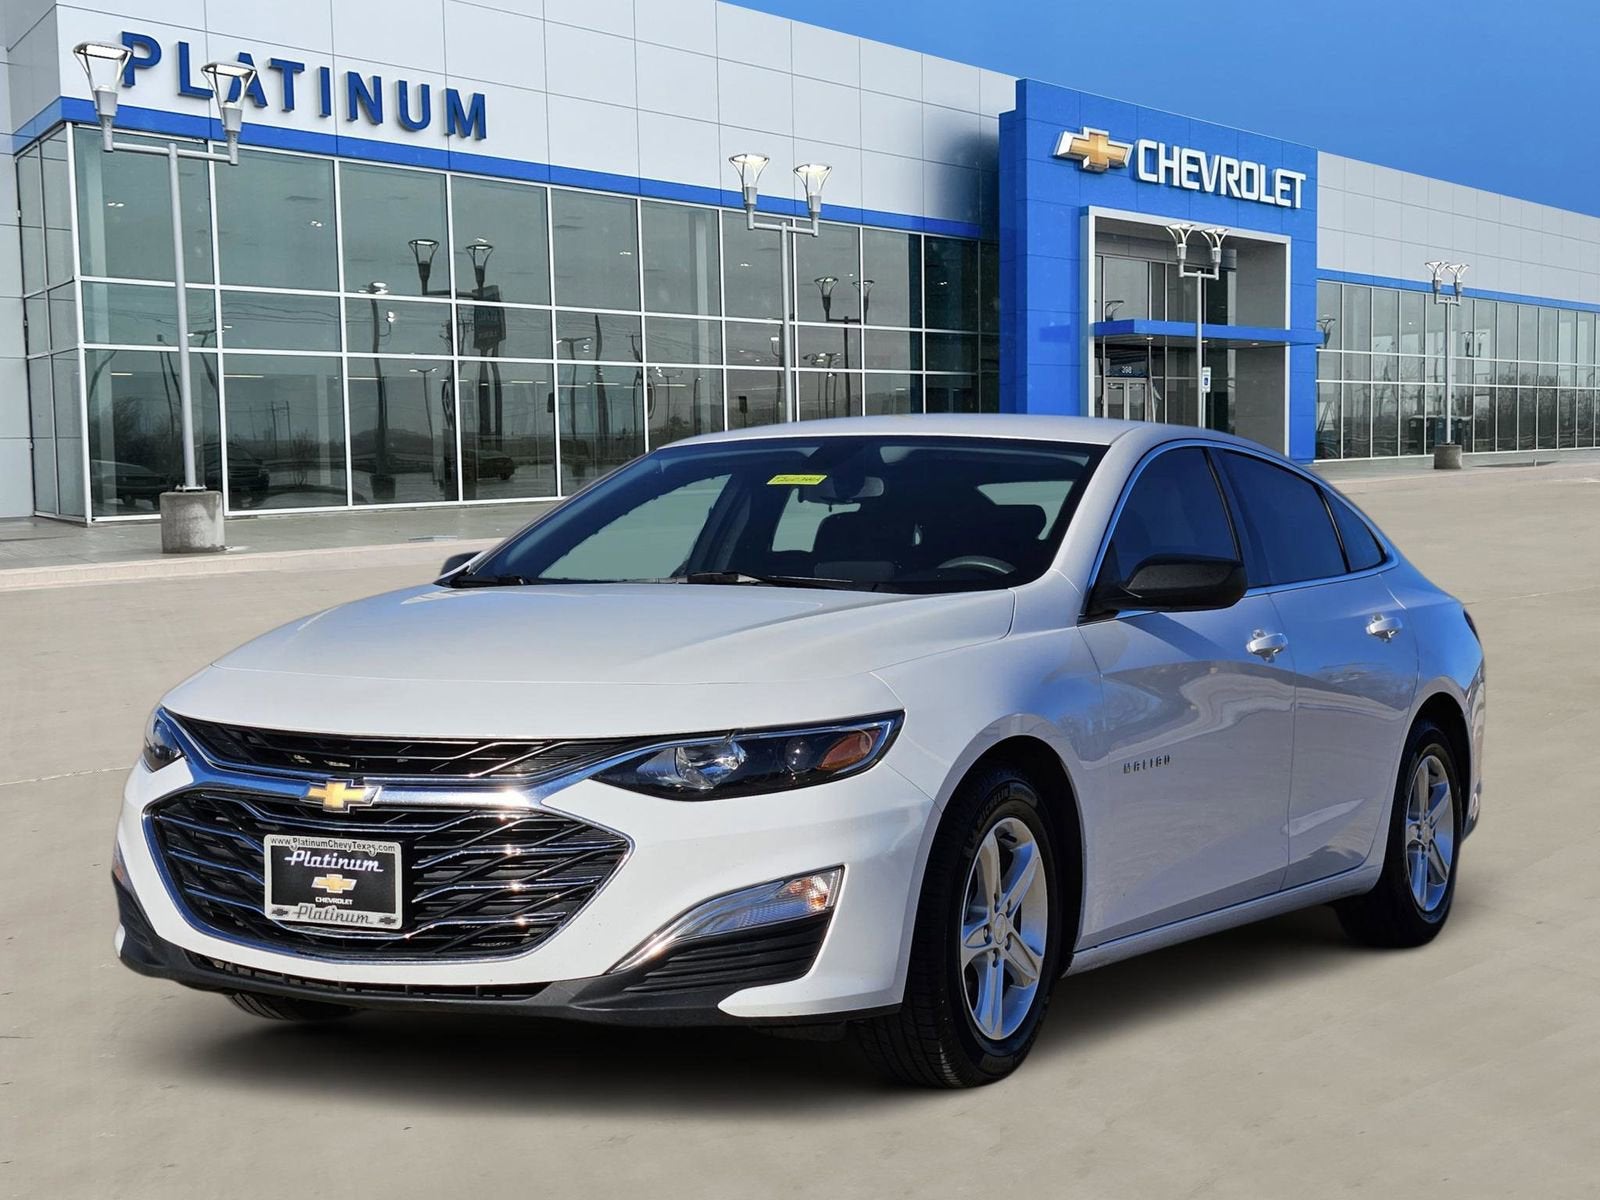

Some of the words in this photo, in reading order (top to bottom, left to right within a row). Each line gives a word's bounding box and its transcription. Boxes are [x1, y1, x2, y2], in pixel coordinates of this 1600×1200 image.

[119, 31, 487, 140] PLATINUM
[1136, 138, 1306, 209] CHEVROLET
[284, 850, 384, 873] Platinum
[315, 896, 353, 905] CHEVROLET
[293, 904, 375, 925] Platinum
